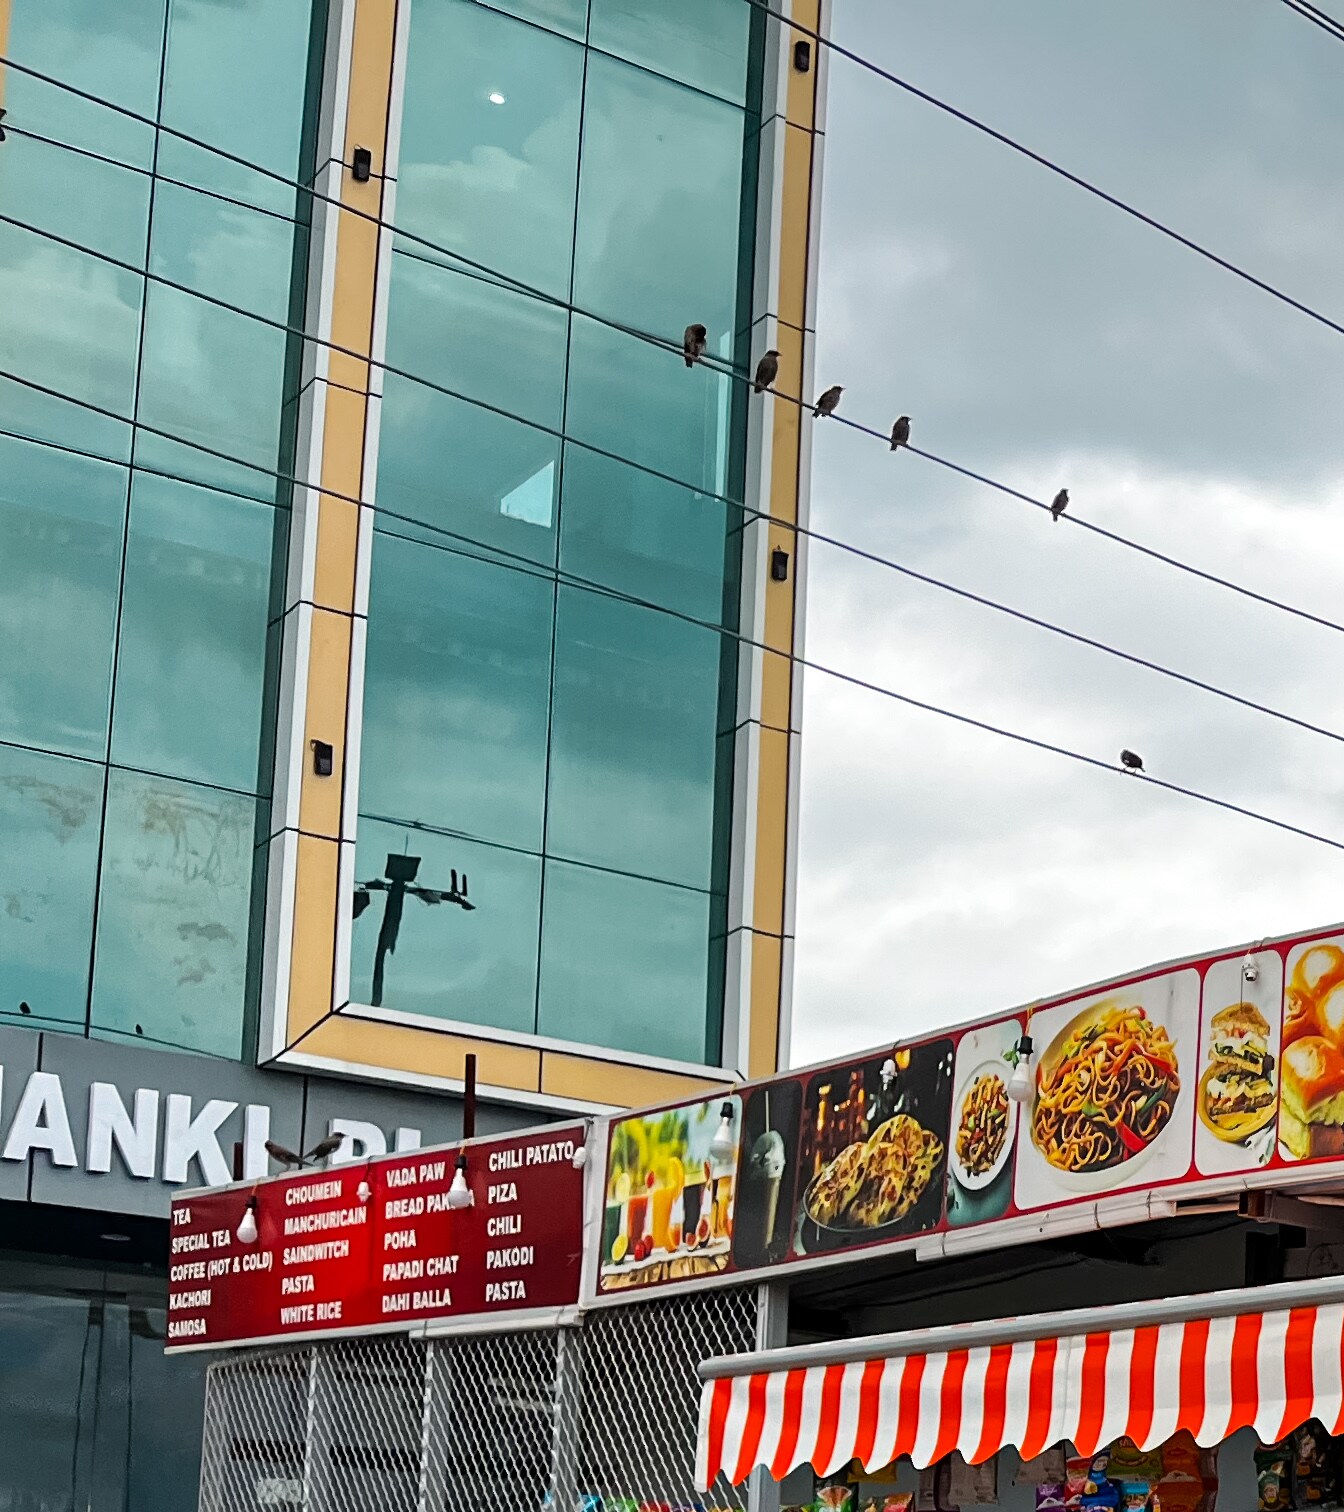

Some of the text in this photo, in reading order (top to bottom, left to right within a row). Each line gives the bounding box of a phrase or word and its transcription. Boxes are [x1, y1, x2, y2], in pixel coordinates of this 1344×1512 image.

[0, 1066, 271, 1186] ANKI
[488, 1141, 574, 1172] CHILI PATATO
[386, 1161, 446, 1189] VADA PAW
[285, 1179, 343, 1207] CHOUMEIN
[385, 1188, 475, 1220] BREAD PAKA
[487, 1181, 518, 1205] PIZA
[173, 1207, 192, 1226] TEA
[487, 1214, 522, 1237] CHILI
[171, 1229, 231, 1254] SPECIAL TEA
[384, 1229, 417, 1251] POHA
[170, 1250, 273, 1282] COFFEE (HOT & COLD)
[382, 1254, 460, 1282] PAPADI CHAT
[486, 1245, 534, 1270] PAKODI
[281, 1274, 315, 1295] PASTA
[485, 1279, 526, 1303] PASTA
[169, 1289, 212, 1311] KACHORI
[382, 1288, 452, 1313] DAHI BALLA
[280, 1301, 343, 1325] WHITE RICE
[168, 1318, 207, 1338] SAMOSA
